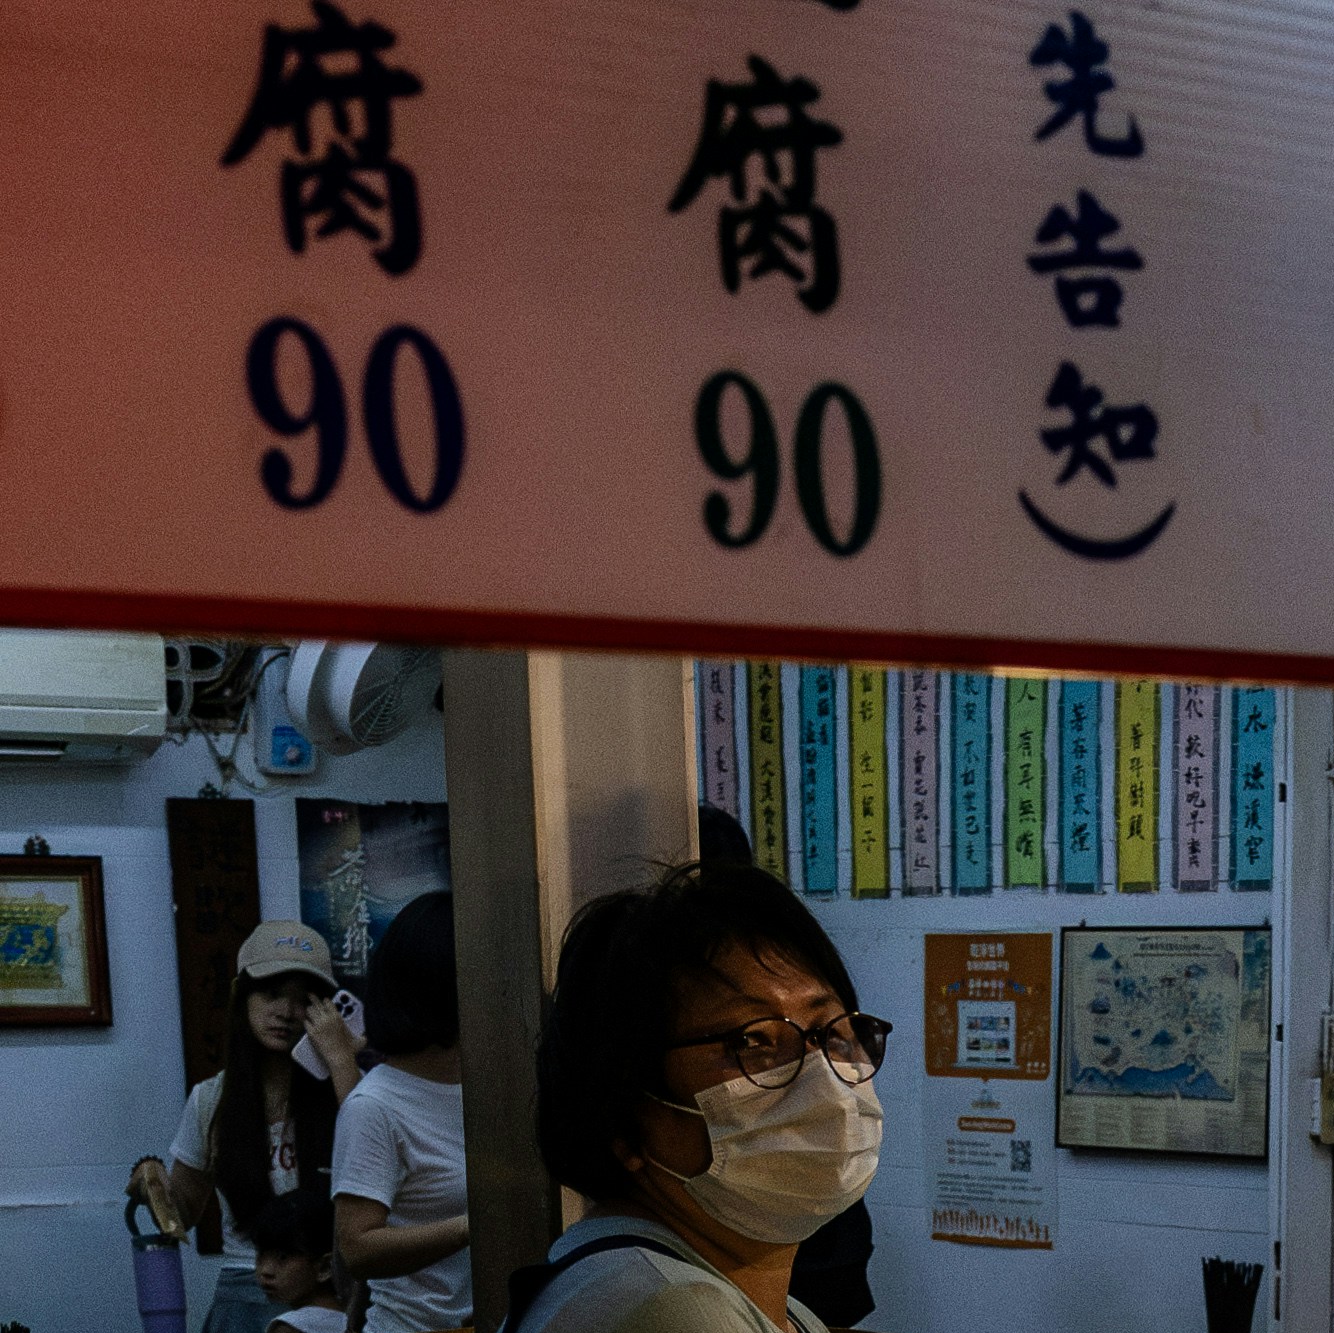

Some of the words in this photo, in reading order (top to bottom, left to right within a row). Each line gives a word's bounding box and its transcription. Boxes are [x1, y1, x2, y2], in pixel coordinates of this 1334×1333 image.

[220, 0, 424, 277] 腐
[245, 316, 466, 515] 90
[693, 369, 882, 558] 90
